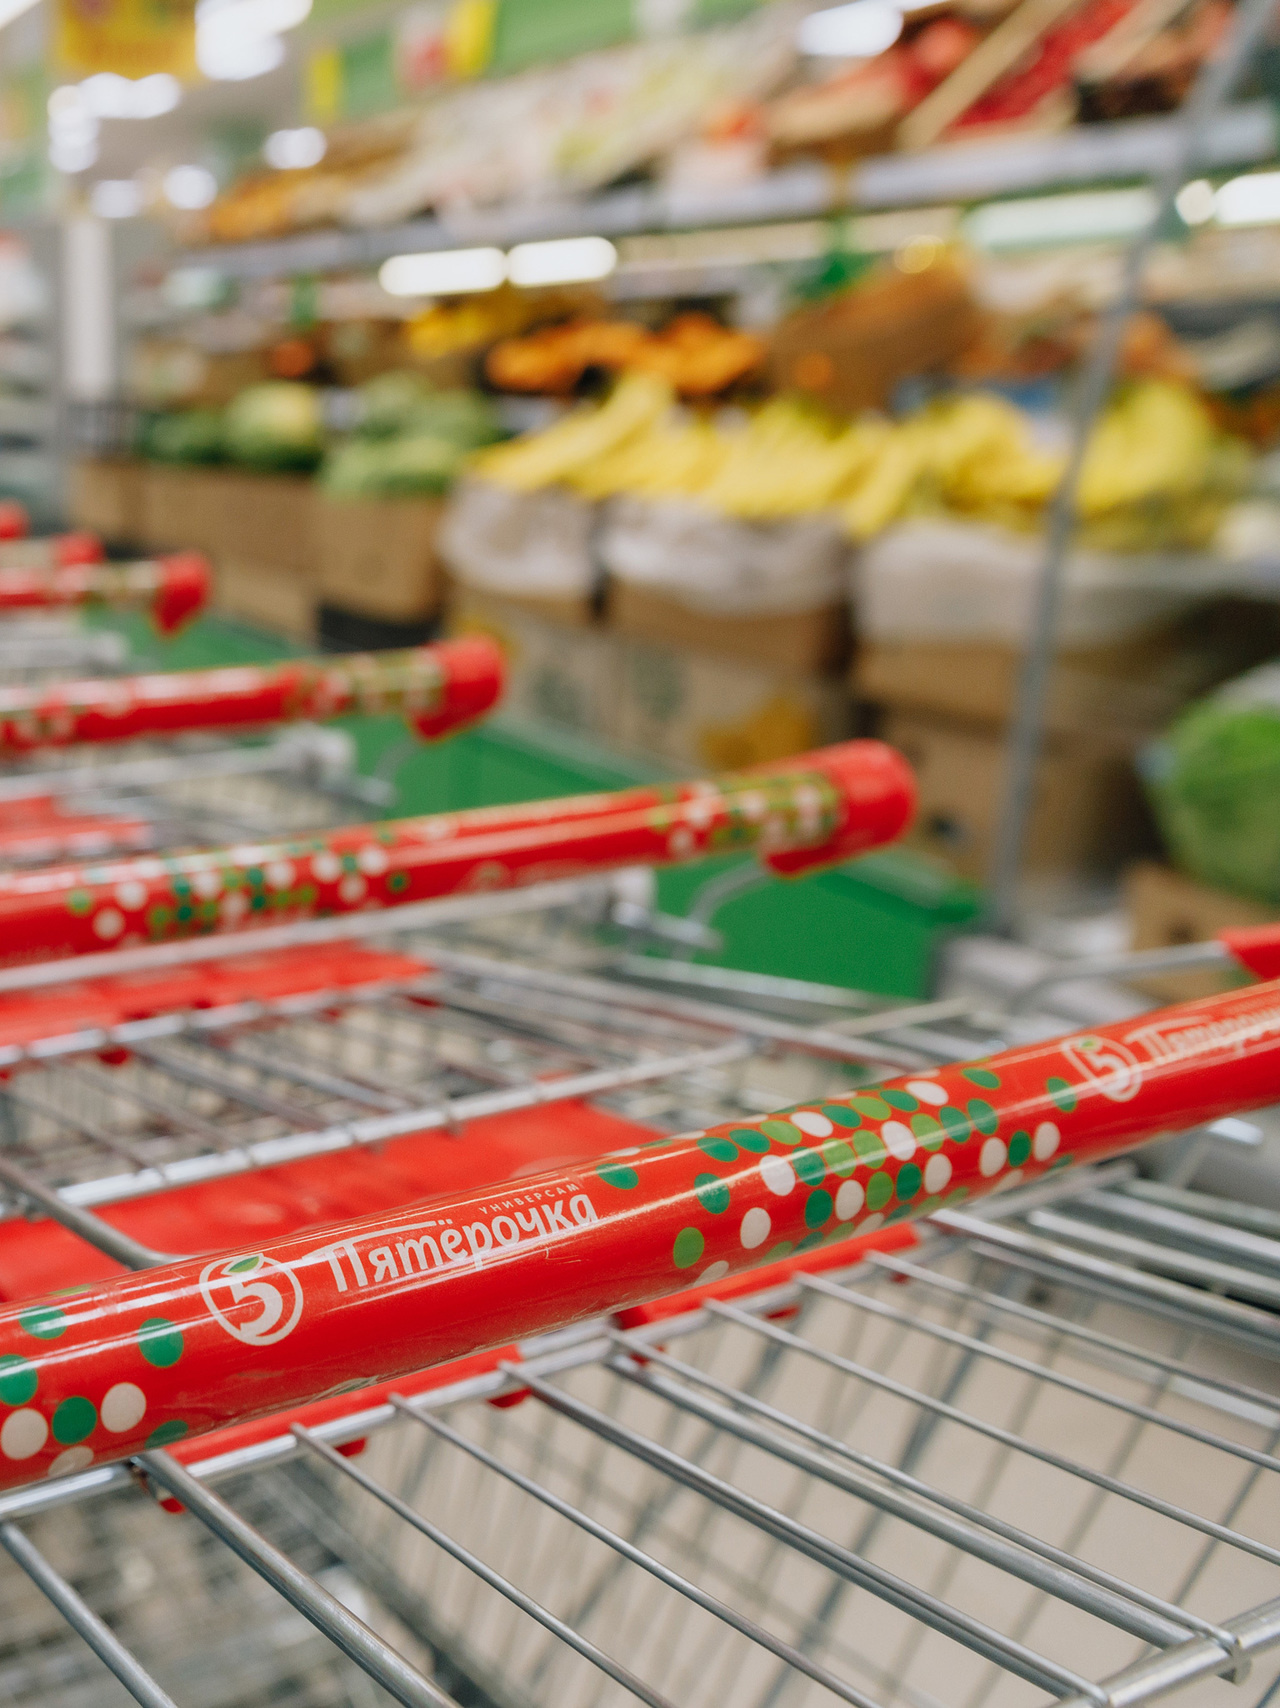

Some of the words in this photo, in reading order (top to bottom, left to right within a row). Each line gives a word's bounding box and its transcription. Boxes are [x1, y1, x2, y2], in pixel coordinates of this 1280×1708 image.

[478, 1183, 580, 1215] УНИВЕРСАМ
[218, 1254, 289, 1341] 5
[301, 1194, 602, 1293] Пятёрочка
